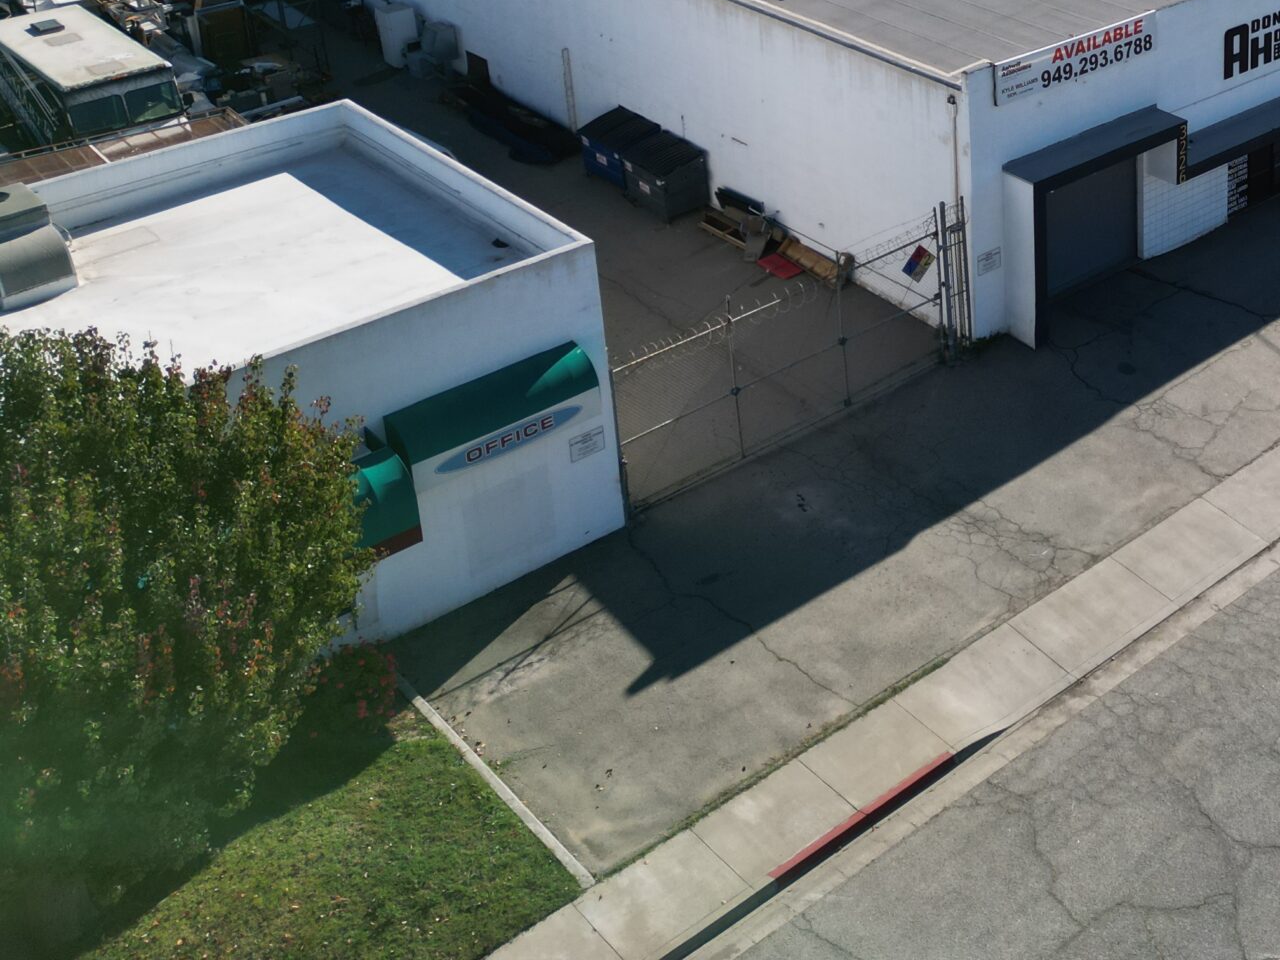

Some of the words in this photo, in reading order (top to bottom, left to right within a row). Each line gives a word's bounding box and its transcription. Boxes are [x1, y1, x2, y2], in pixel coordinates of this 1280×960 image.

[1041, 34, 1153, 88] 949.293.6788
[1052, 19, 1144, 64] AVAILABLE
[465, 415, 556, 464] OFFICE
